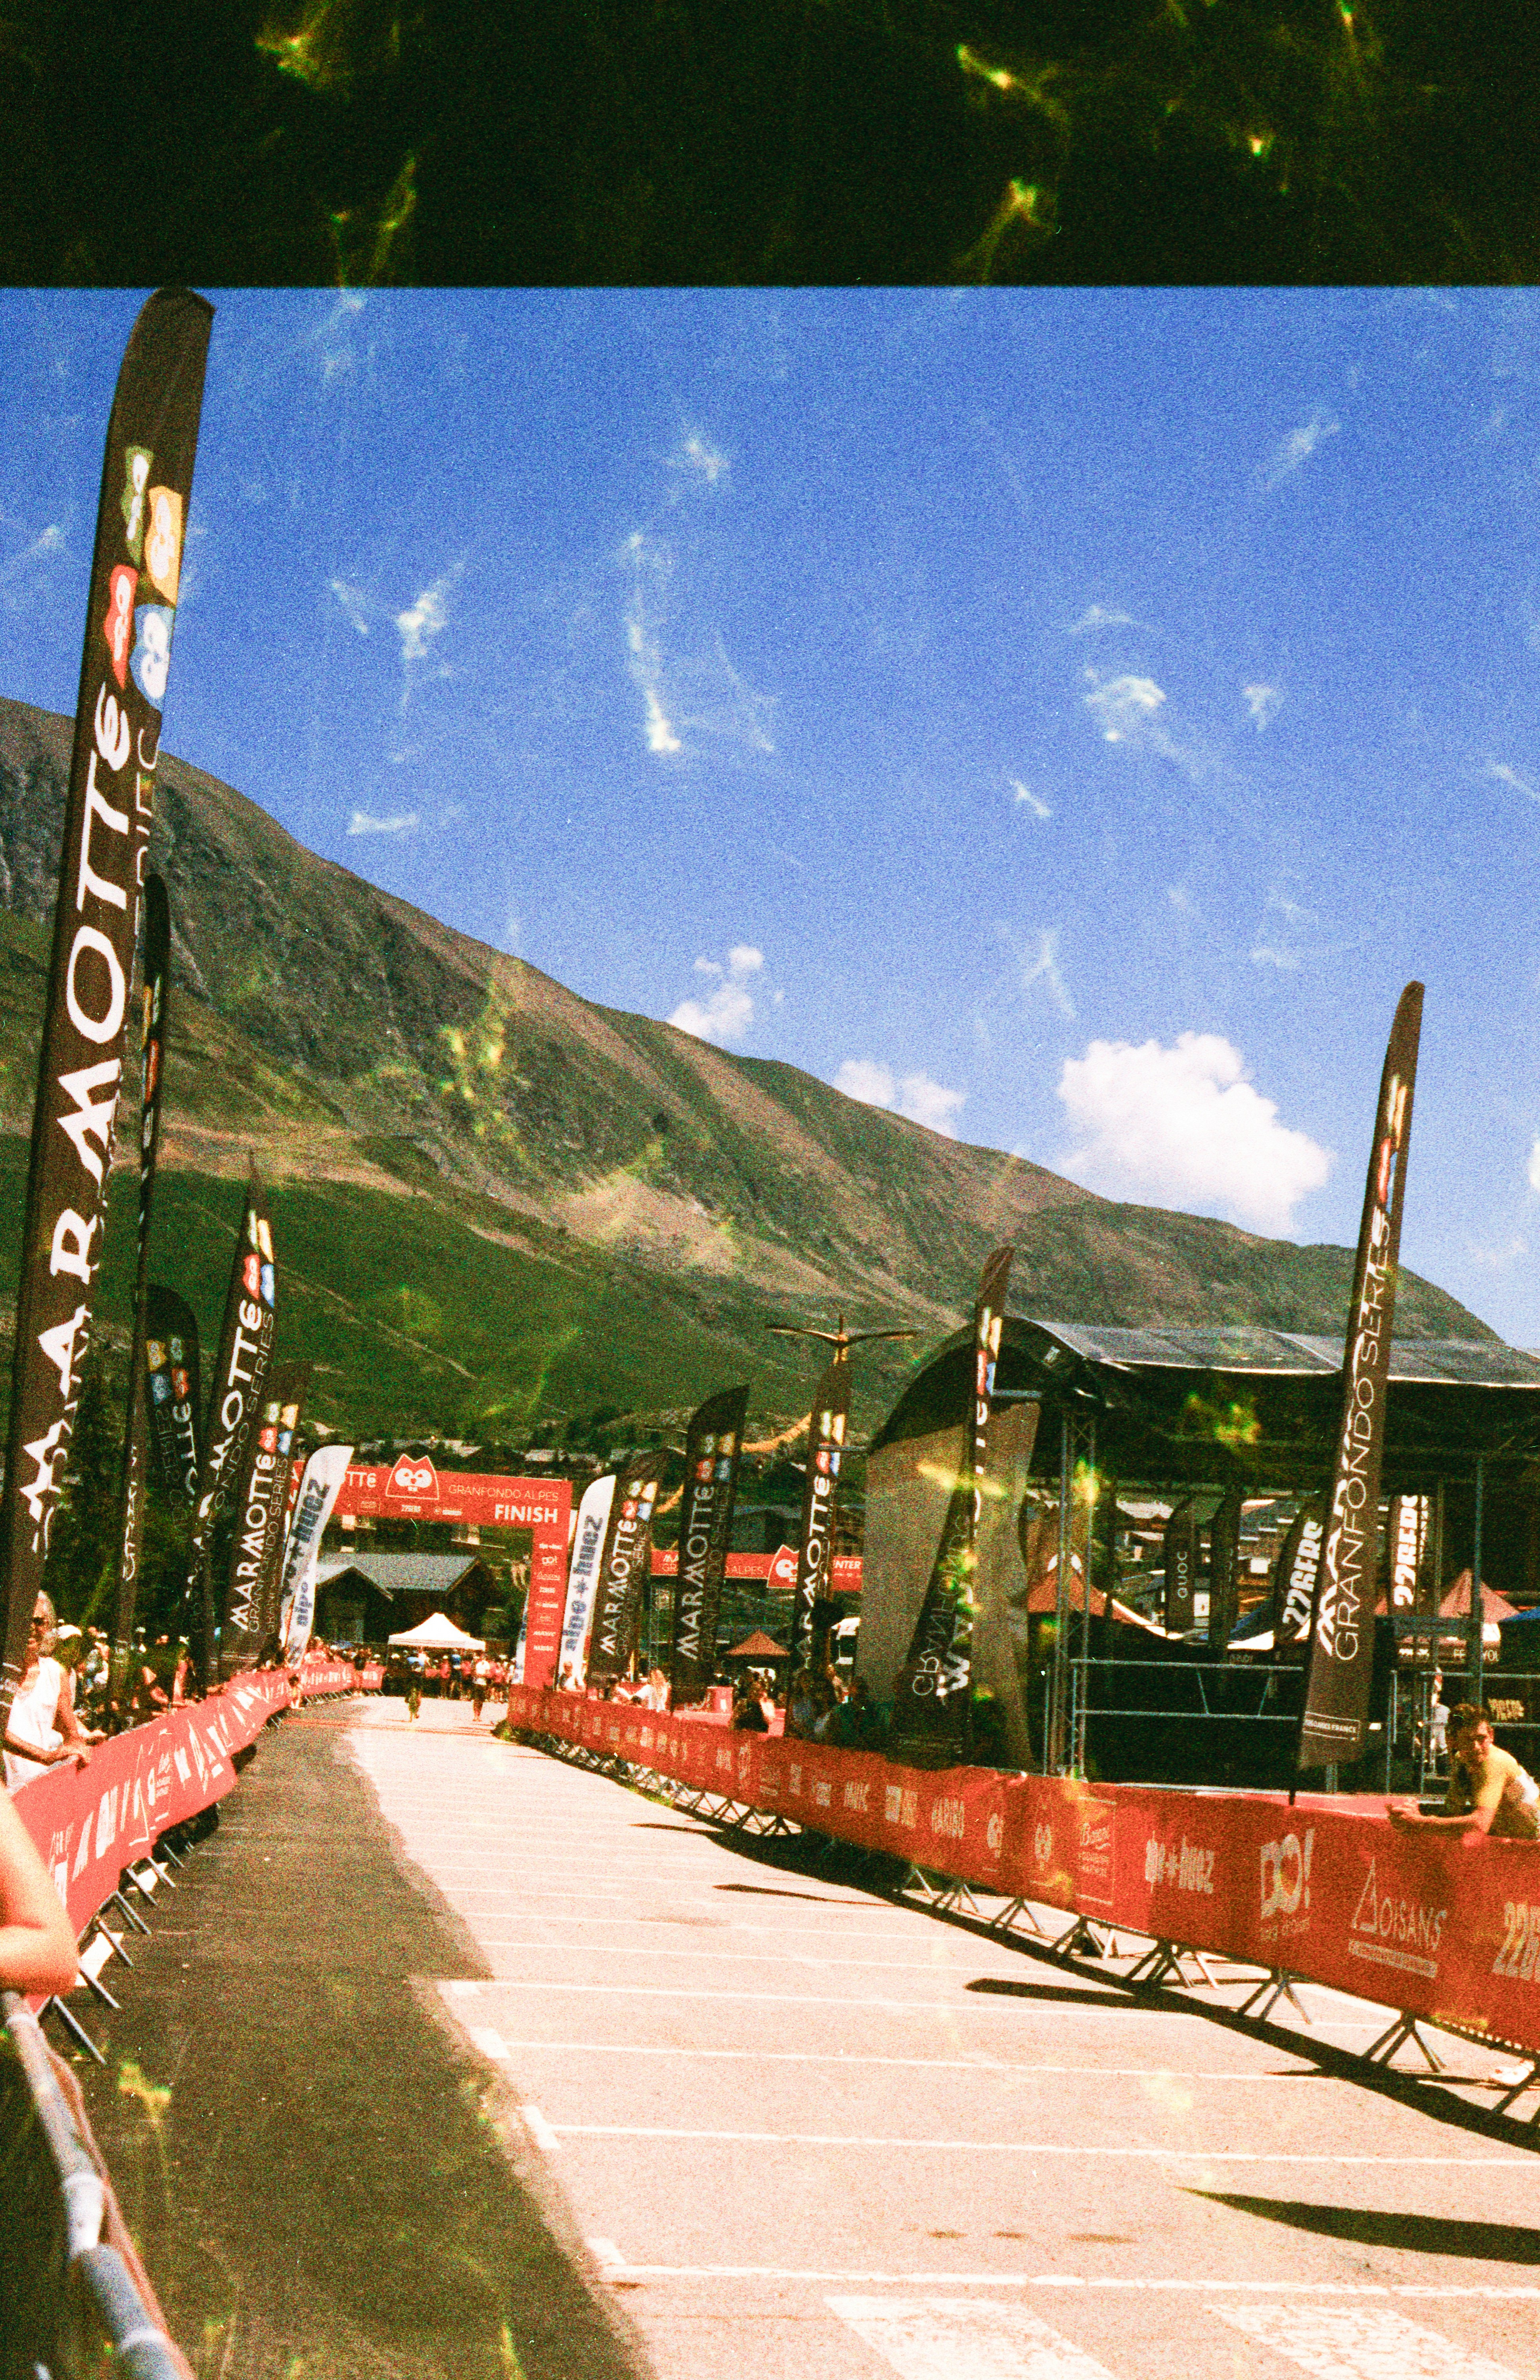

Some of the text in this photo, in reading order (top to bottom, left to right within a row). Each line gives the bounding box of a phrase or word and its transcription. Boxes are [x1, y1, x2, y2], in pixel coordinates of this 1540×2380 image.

[246, 1311, 273, 1415] SERIES
[269, 1457, 289, 1517] SERIES
[449, 1484, 558, 1501] GRANFONDO ALPES
[495, 1504, 558, 1524] FINISH
[1335, 1378, 1374, 1660] GRANFONDO
[230, 1453, 276, 1631] MARMOTTE
[676, 1486, 714, 1660] MARMOTTE
[731, 1565, 763, 1576] ALPES
[1177, 1551, 1189, 1599] QUOC
[562, 1515, 603, 1652] alpe huez
[600, 1520, 638, 1655] MARMOTTE
[1379, 1897, 1447, 1952] OISANS
